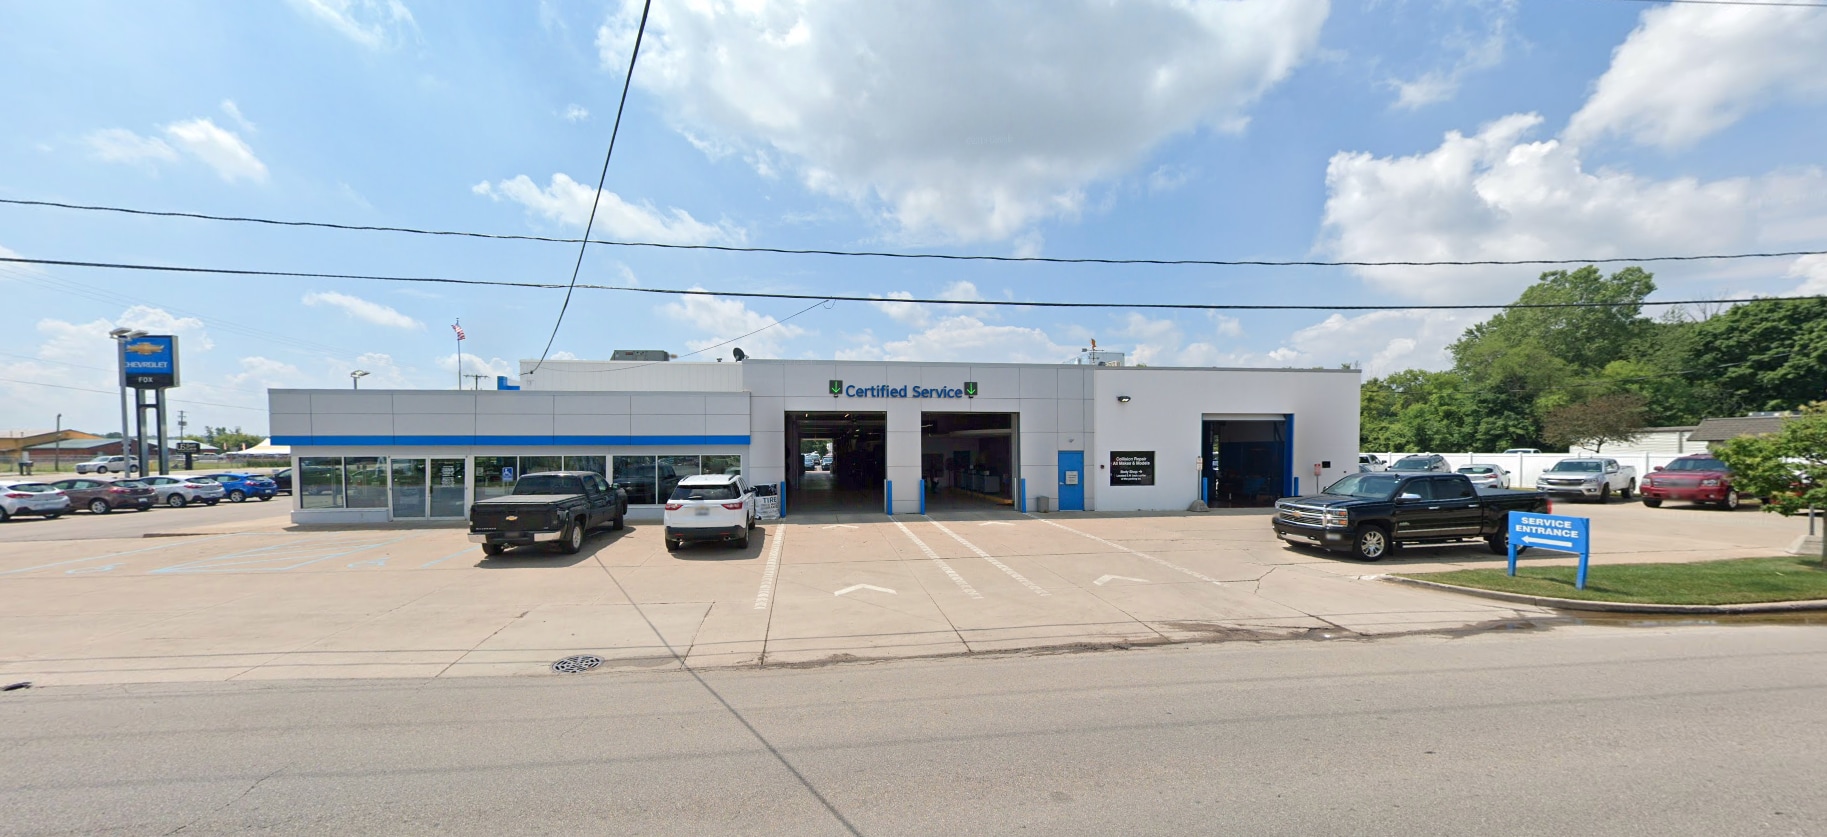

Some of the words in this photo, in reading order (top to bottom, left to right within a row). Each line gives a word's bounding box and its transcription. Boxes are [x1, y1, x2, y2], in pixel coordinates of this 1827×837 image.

[845, 384, 907, 398] Certified
[912, 385, 963, 398] Service
[1521, 517, 1572, 528] SERVICE
[1515, 525, 1579, 538] ENTRANCE
